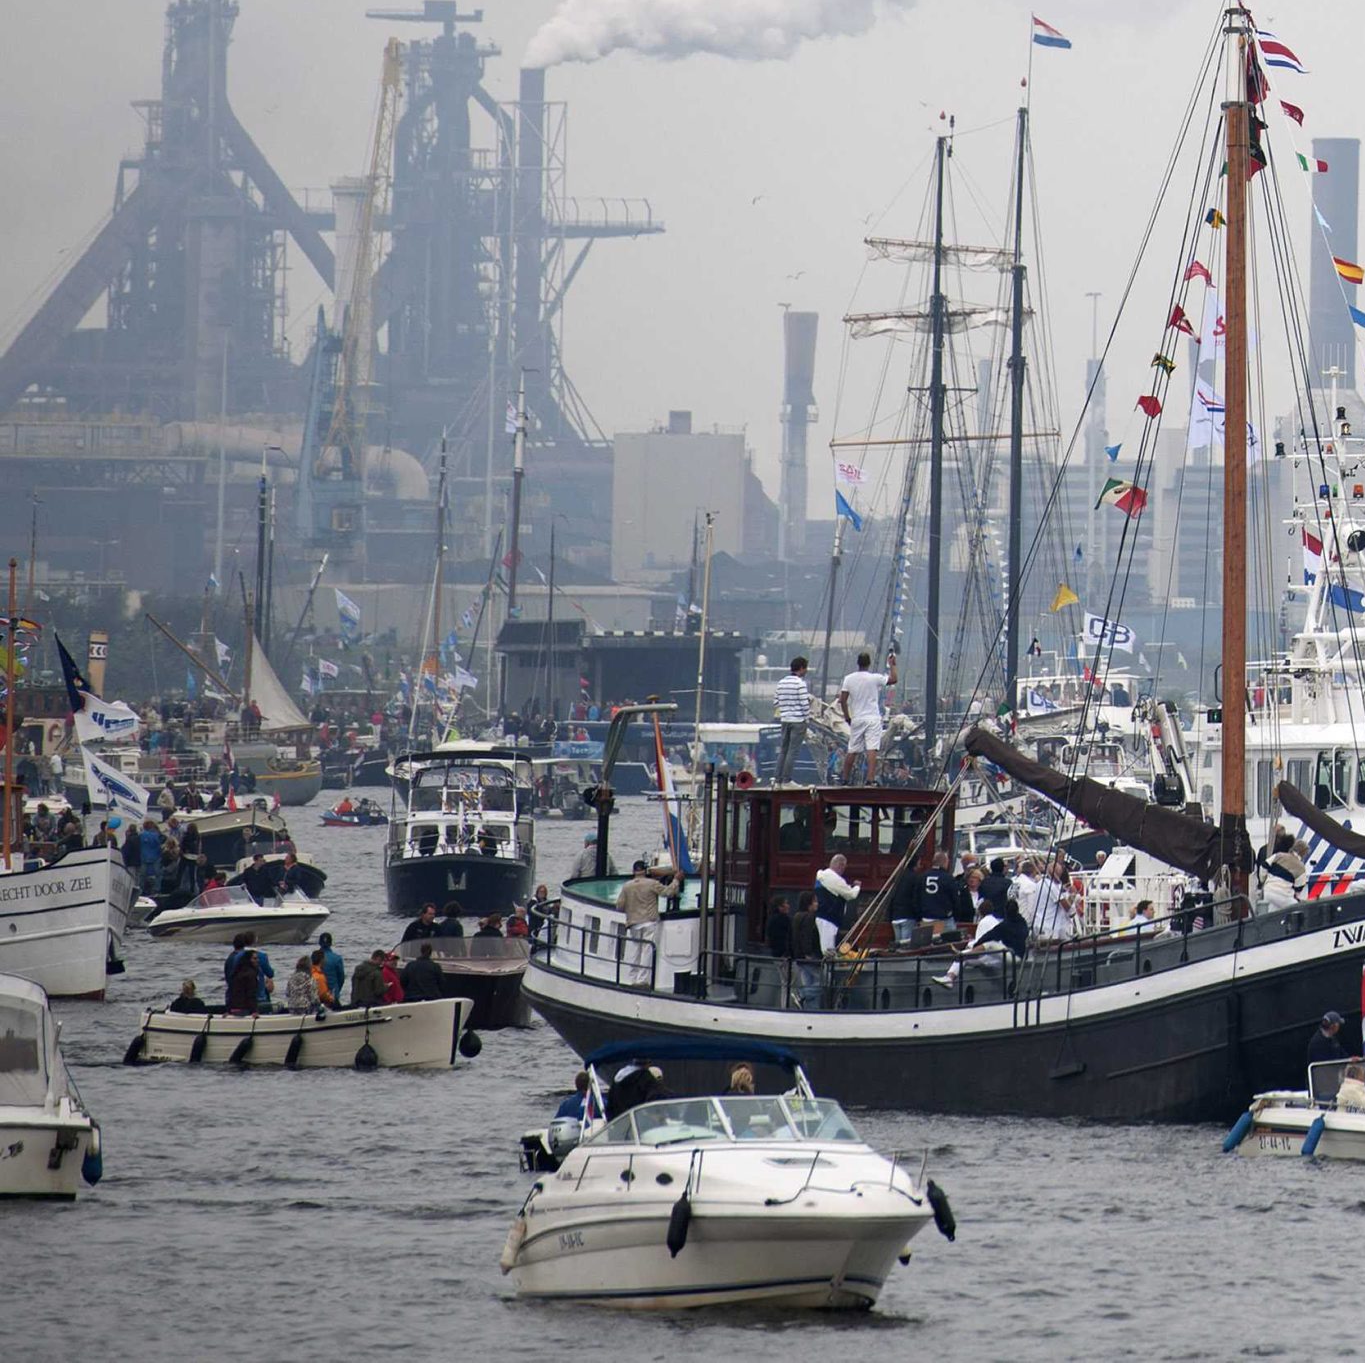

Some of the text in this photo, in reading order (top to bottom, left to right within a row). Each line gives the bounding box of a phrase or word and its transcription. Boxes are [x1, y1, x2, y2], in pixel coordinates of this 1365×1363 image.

[0, 885, 35, 902] ECHT
[34, 881, 66, 897] DOOR
[70, 876, 93, 892] ZEE
[925, 877, 939, 893] 5
